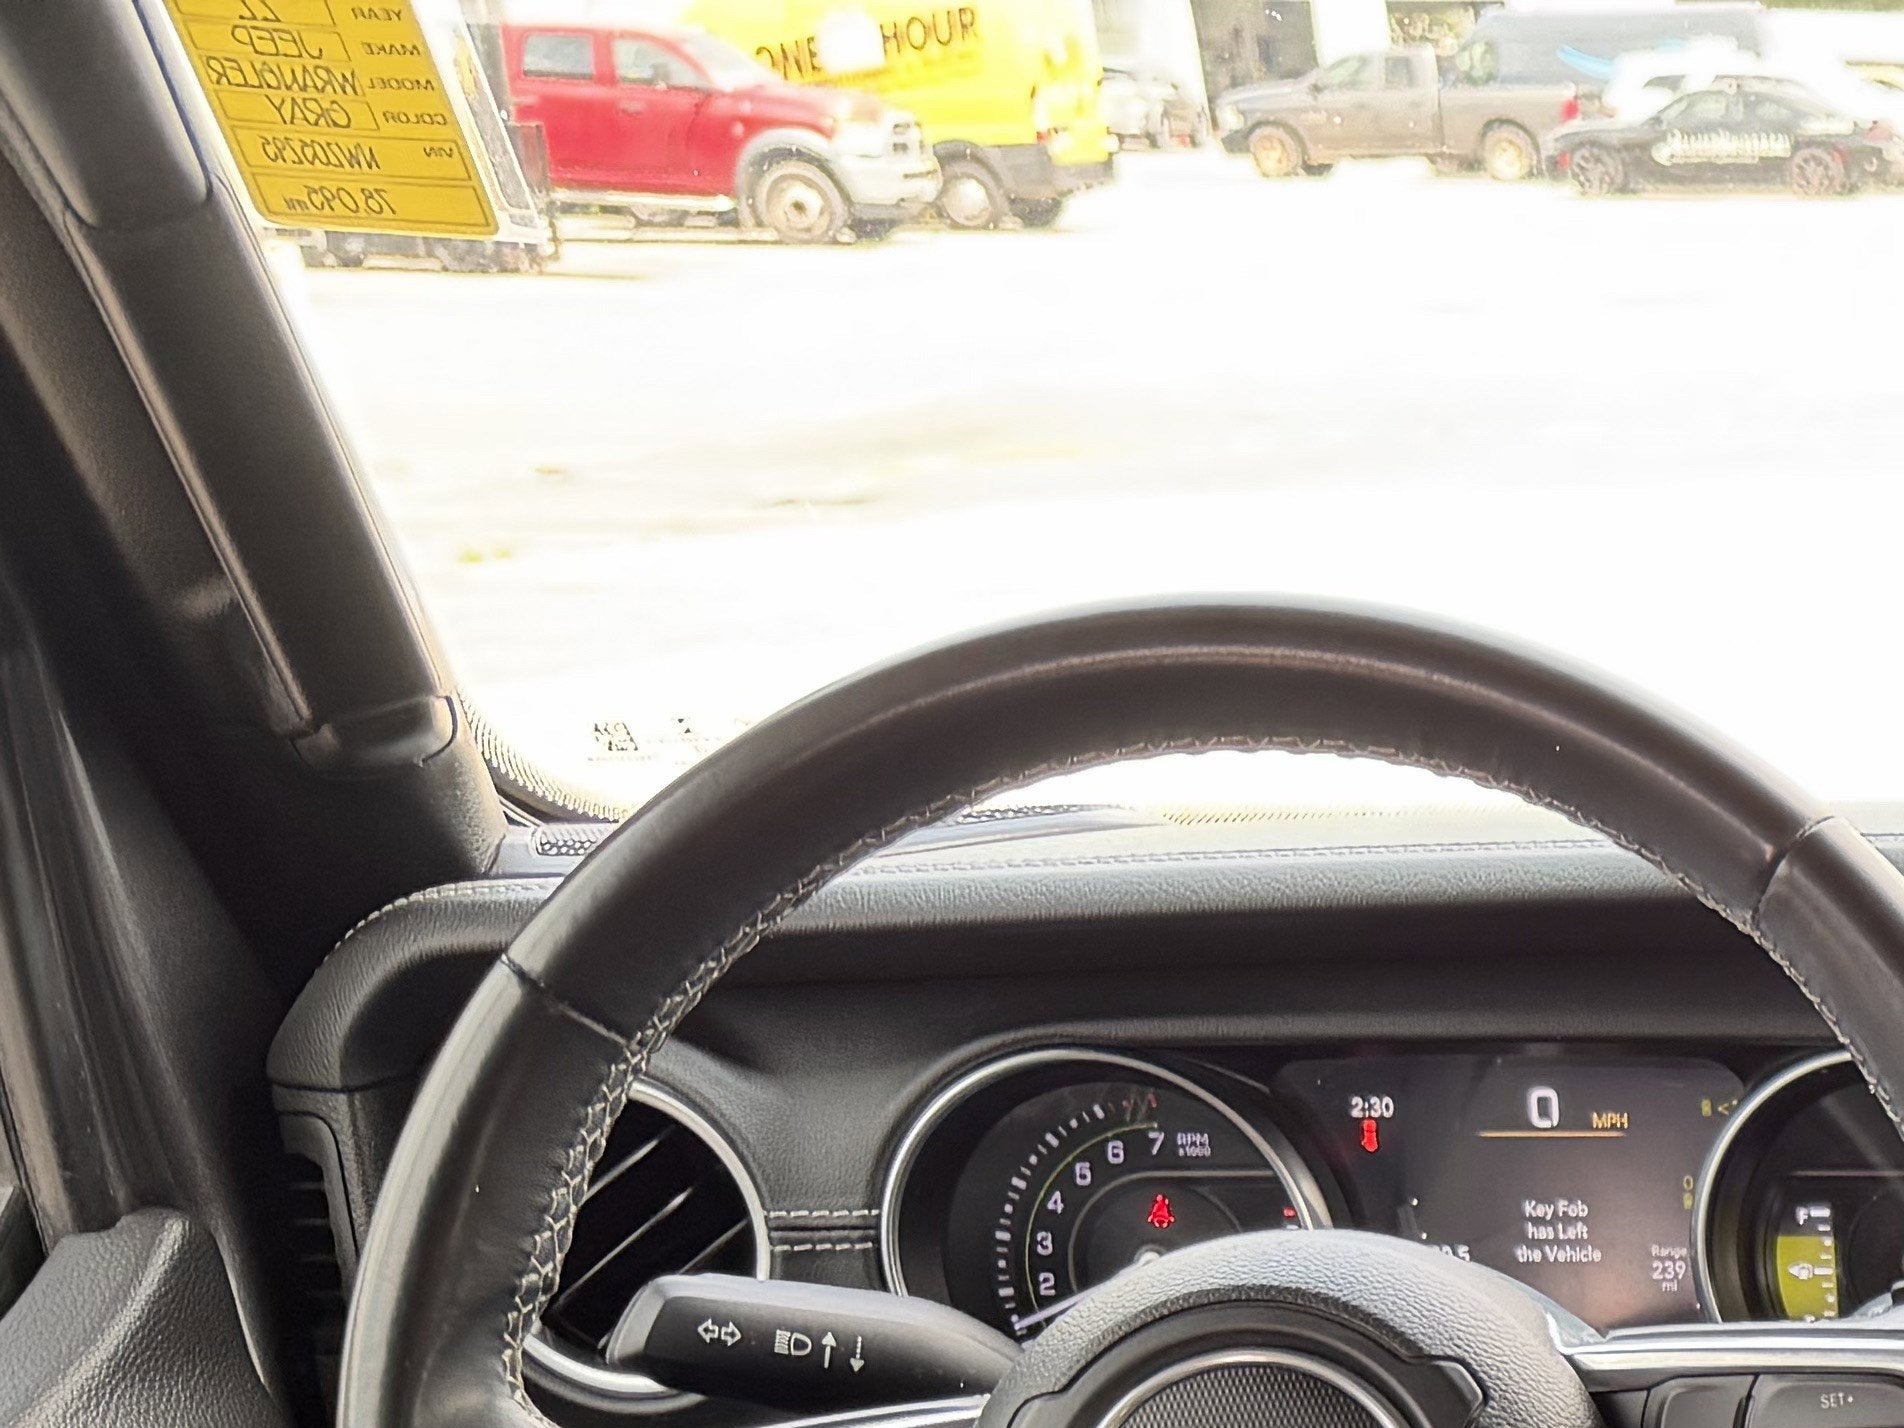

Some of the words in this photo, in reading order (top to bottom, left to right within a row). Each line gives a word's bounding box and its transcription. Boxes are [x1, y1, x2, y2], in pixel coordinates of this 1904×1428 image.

[880, 7, 978, 56] HOUR
[1350, 1096, 1394, 1118] 2:30
[1526, 1085, 1561, 1129] 0
[1592, 1111, 1629, 1130] MPH
[1148, 1131, 1165, 1155] 7
[1176, 1133, 1210, 1148] RPM
[1106, 1140, 1124, 1164] 6
[1074, 1161, 1092, 1186] 5
[1046, 1191, 1064, 1214] 4
[1524, 1199, 1554, 1219] Key
[1558, 1200, 1588, 1217] Fob
[1526, 1223, 1555, 1239] has
[1559, 1222, 1589, 1239] Left
[1036, 1232, 1053, 1255] 3
[1517, 1246, 1541, 1263] the
[1545, 1245, 1602, 1263] Vehicle
[1651, 1245, 1687, 1261] Range
[1652, 1261, 1686, 1279] 239
[1039, 1272, 1056, 1296] 2
[1661, 1279, 1679, 1292] mi
